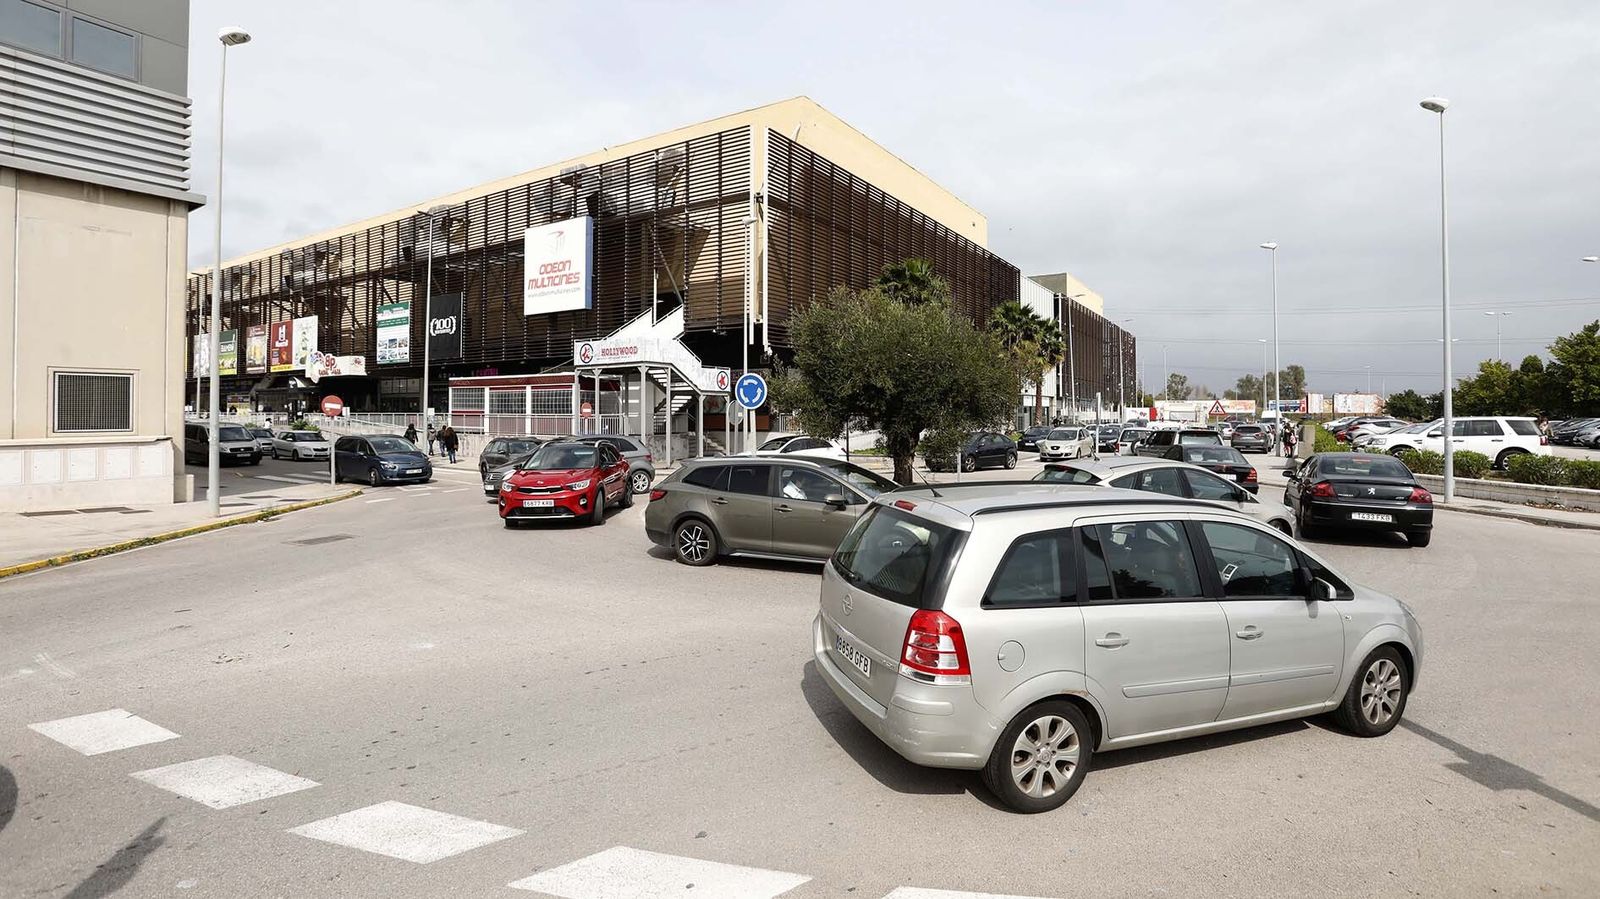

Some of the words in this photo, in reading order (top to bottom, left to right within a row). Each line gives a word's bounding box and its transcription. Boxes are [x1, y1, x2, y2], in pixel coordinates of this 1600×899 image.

[539, 260, 572, 275] ODEON
[527, 272, 581, 290] MULTICINES
[601, 346, 639, 357] HOLLYWOOD
[854, 651, 869, 673] GFB
